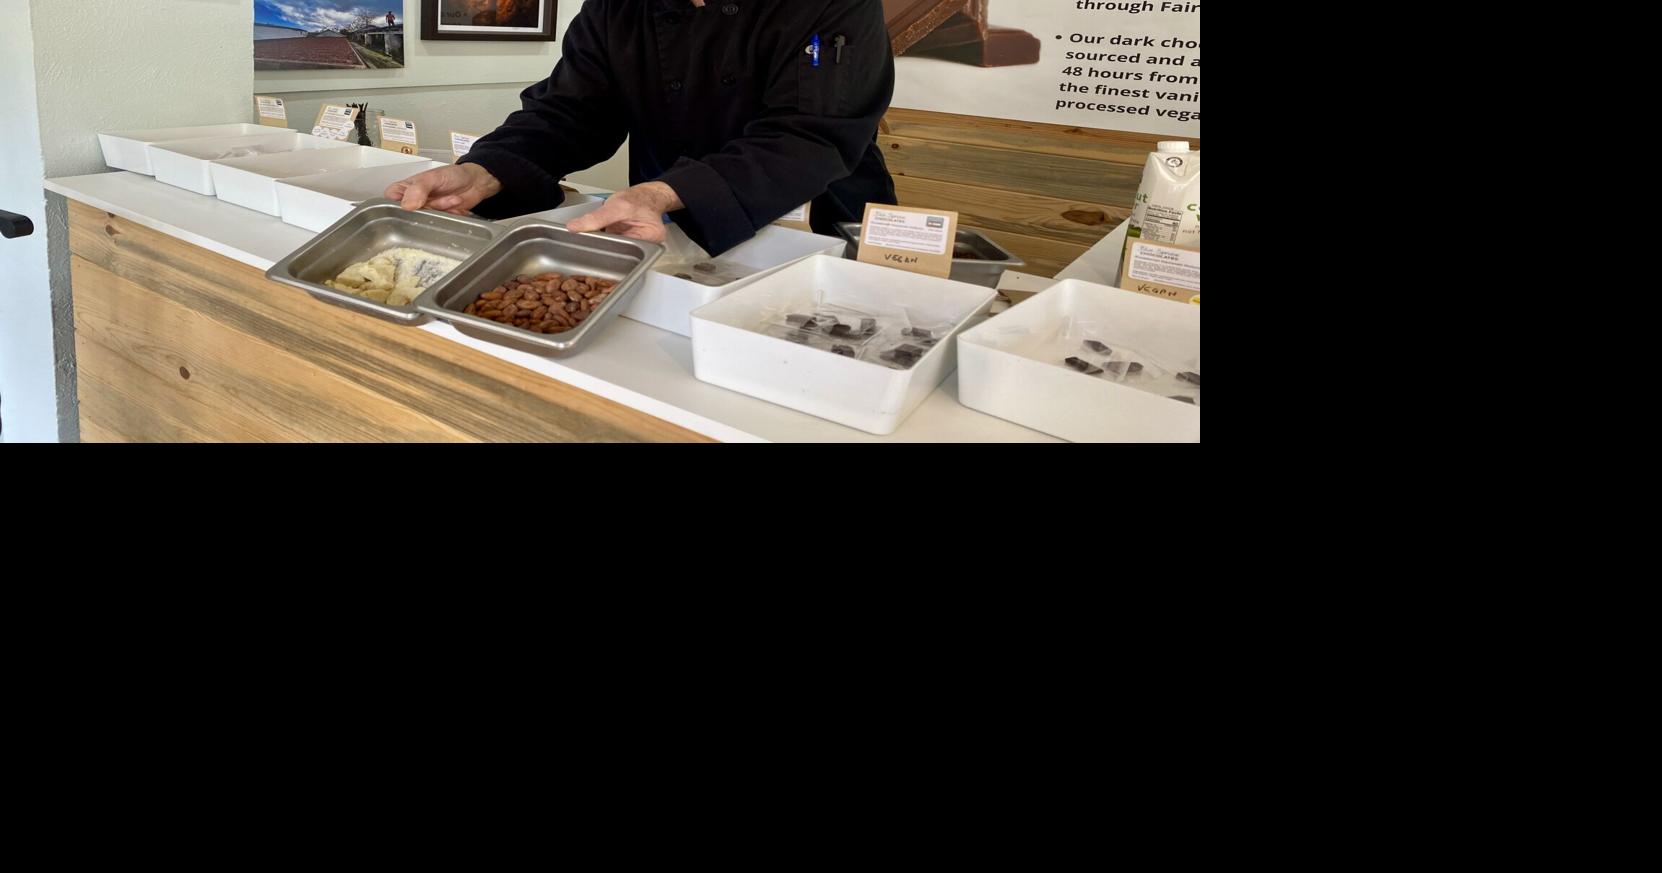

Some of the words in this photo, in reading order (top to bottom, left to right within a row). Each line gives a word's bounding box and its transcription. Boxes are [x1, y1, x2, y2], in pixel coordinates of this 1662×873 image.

[1076, 0, 1154, 14] through
[1160, 1, 1200, 13] Fair
[1069, 33, 1105, 44] Our
[1109, 34, 1156, 47] dark
[1160, 37, 1200, 49] cho
[1065, 51, 1141, 64] sourced
[1146, 55, 1185, 67] and
[1062, 66, 1083, 77] 48
[1087, 67, 1144, 81] hours
[1149, 71, 1198, 85] from
[1059, 82, 1089, 94] the
[1094, 84, 1150, 99] finest
[1155, 91, 1199, 103] vani
[1055, 99, 1150, 116] processed
[1155, 108, 1200, 122] vega
[884, 253, 918, 264] VEGAN
